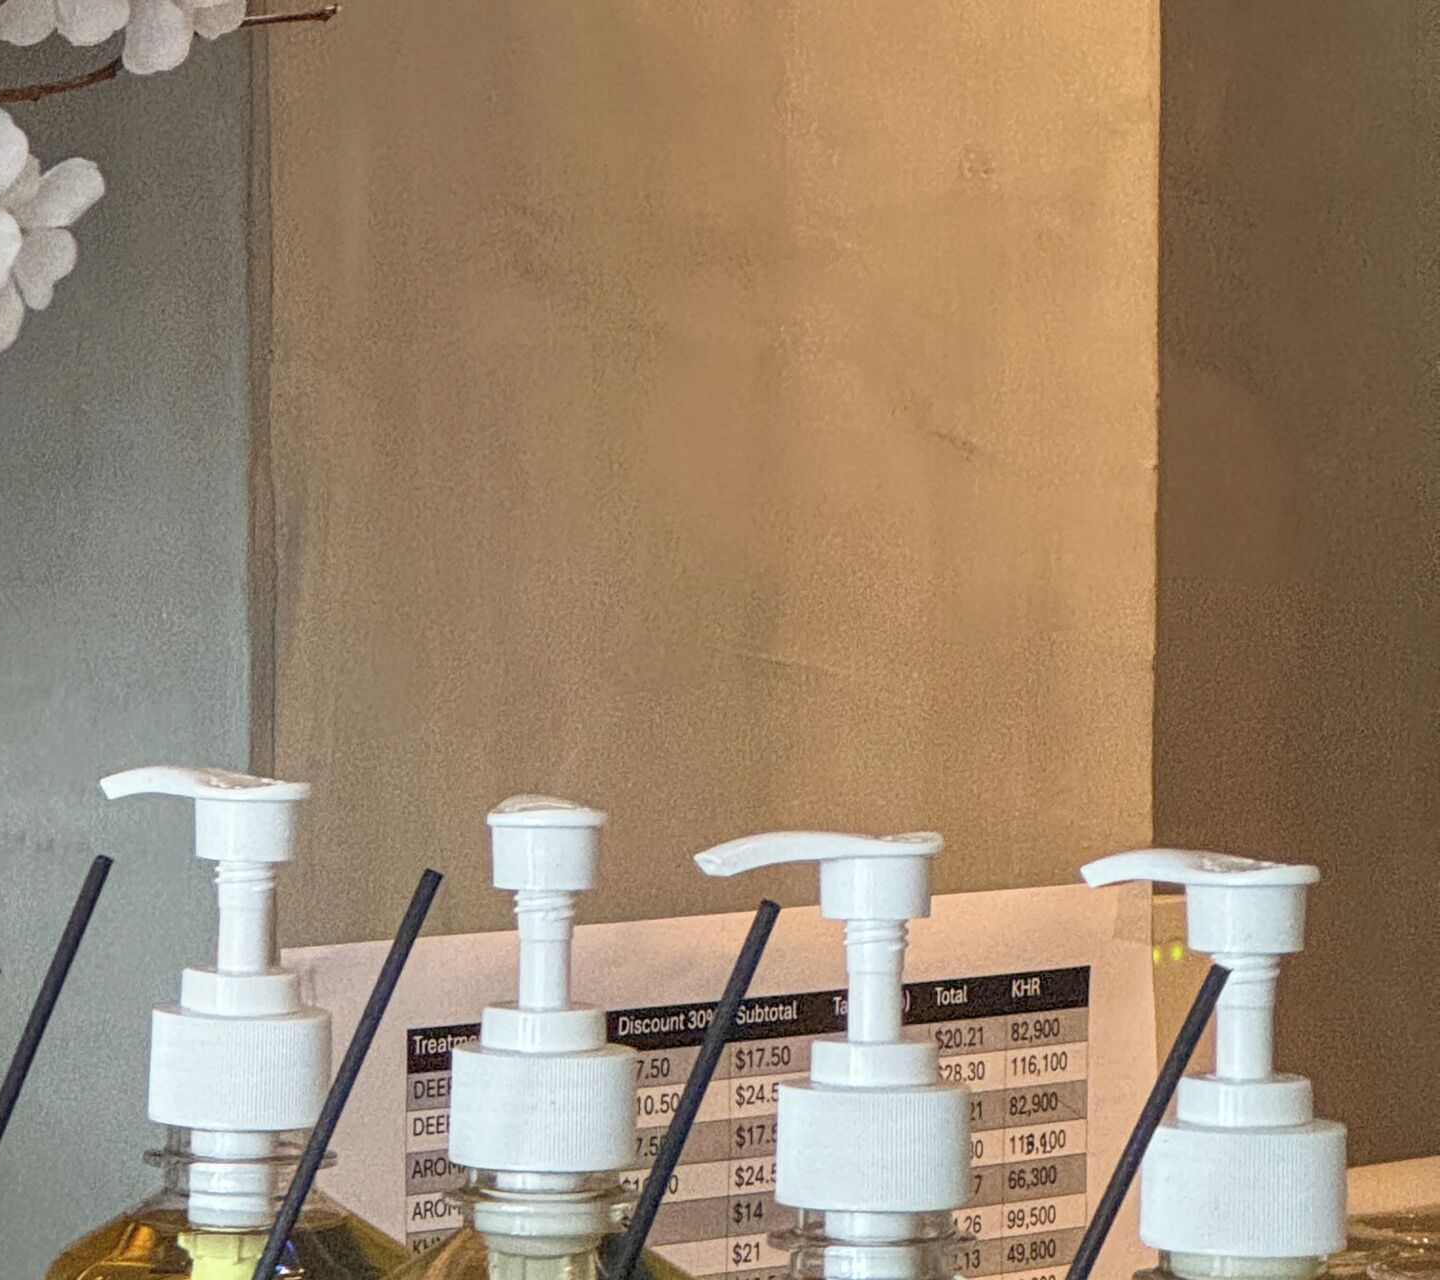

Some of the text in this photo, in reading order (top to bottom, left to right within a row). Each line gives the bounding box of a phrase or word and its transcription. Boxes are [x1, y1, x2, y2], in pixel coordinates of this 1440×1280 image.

[618, 1013, 685, 1036] Discount
[735, 1000, 798, 1024] Subtotal
[934, 985, 968, 1006] Total
[1011, 977, 1041, 998] KHR
[735, 1045, 791, 1071] $17.50
[935, 1026, 984, 1051] $20.21
[1011, 1018, 1061, 1041] 82,900
[1011, 1051, 1068, 1076] 116,100
[636, 1135, 666, 1157] 7.5
[1009, 1092, 1059, 1116] 82,900
[733, 1200, 764, 1224] $14
[1008, 1165, 1058, 1190] 66,300
[732, 1242, 761, 1266] $21
[1007, 1204, 1057, 1230] 99,500
[1006, 1239, 1057, 1264] 49,800
